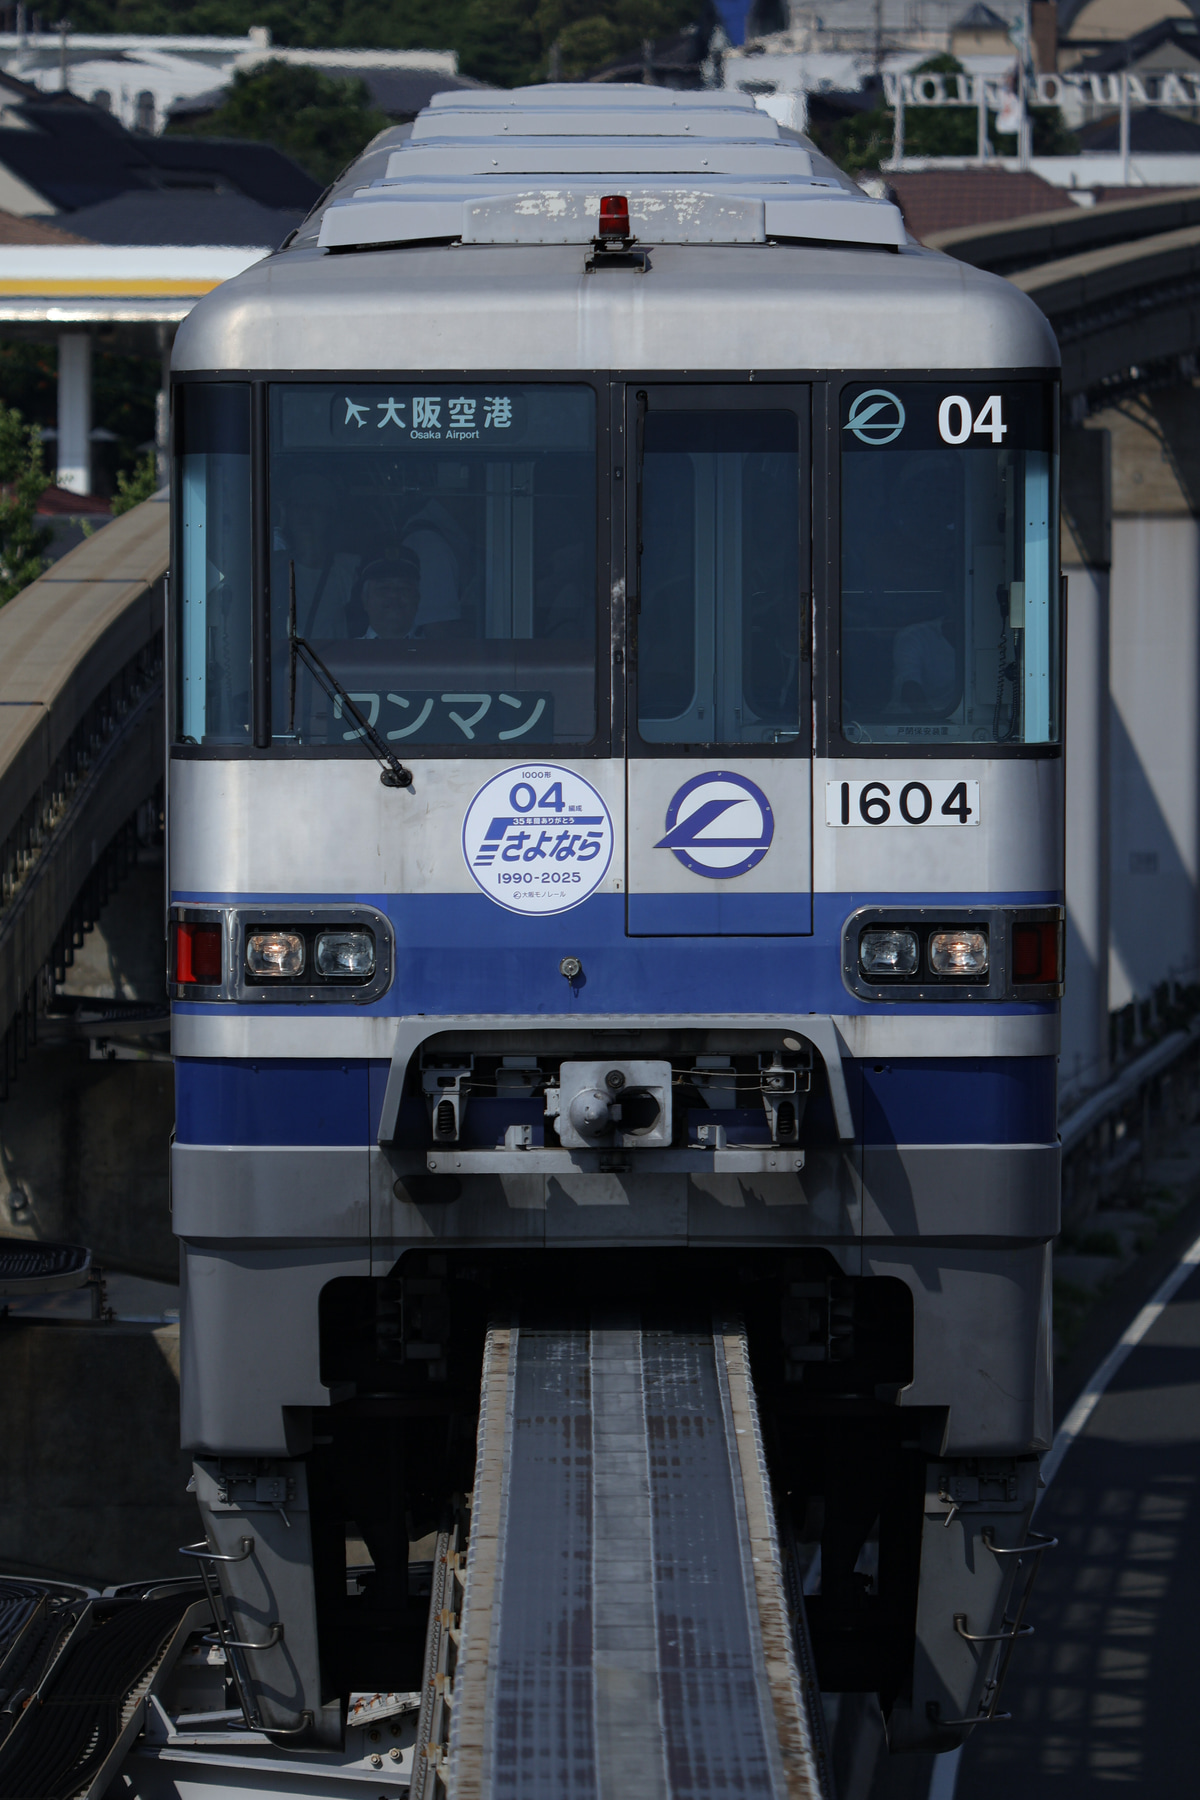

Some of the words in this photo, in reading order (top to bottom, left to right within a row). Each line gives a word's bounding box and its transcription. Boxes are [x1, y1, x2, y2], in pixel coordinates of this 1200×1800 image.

[377, 396, 512, 428] 大阪空港
[938, 395, 1007, 444] 04
[410, 430, 441, 440] Osaka
[445, 429, 480, 440] Airport
[334, 693, 546, 740] ワンマン
[522, 771, 552, 779] 1000形
[509, 782, 566, 813] 04
[841, 781, 972, 825] 1604
[512, 817, 575, 825] 35年間ありがとう
[501, 830, 604, 862] さよなら
[497, 871, 582, 884] 1990-2025
